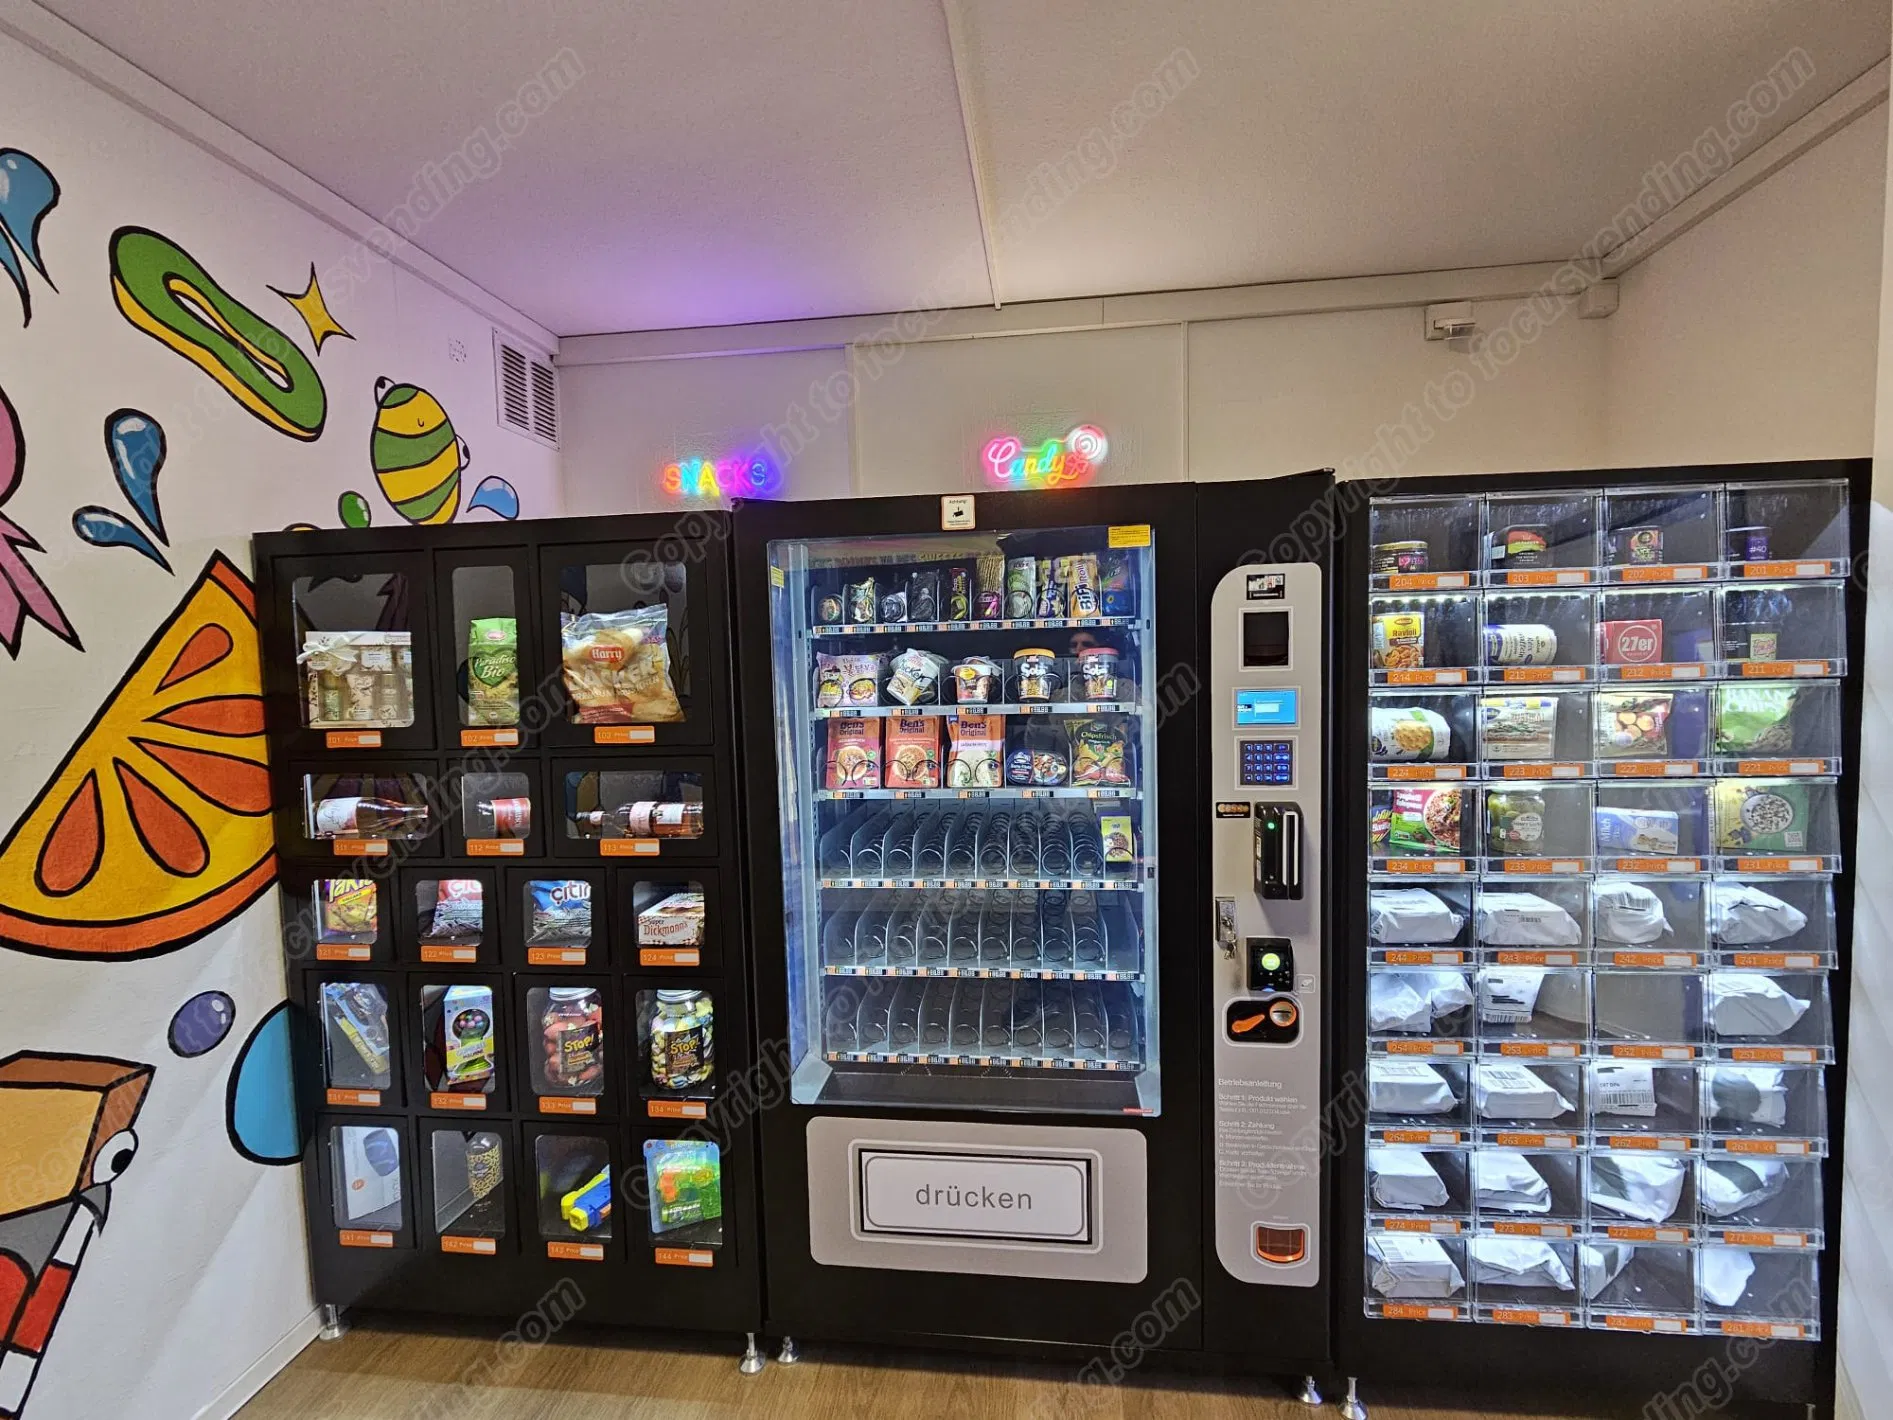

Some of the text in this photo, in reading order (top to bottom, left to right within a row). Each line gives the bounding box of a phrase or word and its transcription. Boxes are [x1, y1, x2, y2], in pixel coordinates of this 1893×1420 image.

[988, 441, 1078, 485] Candy
[664, 459, 766, 496] SNACKS
[1750, 566, 1767, 574] 201
[1512, 575, 1529, 583] 203
[1628, 571, 1644, 579] 202
[1395, 578, 1412, 587] 204
[1075, 583, 1092, 610] BiFi
[1392, 629, 1417, 637] Ravioli
[1621, 636, 1654, 652] 27er
[591, 648, 622, 660] Harry
[474, 654, 516, 668] Paradiso
[480, 665, 505, 678] Bio
[1748, 665, 1765, 673] 211
[1393, 673, 1410, 682] 214
[1509, 671, 1526, 680] 213
[900, 718, 925, 727] Ben's
[960, 720, 986, 729] Ben's
[839, 727, 864, 735] Original
[899, 726, 925, 734] Original
[960, 728, 986, 736] Original
[1081, 731, 1116, 741] Chipsfrisch
[1393, 769, 1409, 777] 224
[1392, 863, 1408, 871] 234
[1509, 863, 1526, 871] 233
[1743, 861, 1759, 869] 231
[1391, 954, 1407, 962] 244
[1503, 955, 1518, 963] 243
[564, 1034, 594, 1053] STOP!
[670, 1037, 700, 1054] STOP!
[1392, 1044, 1408, 1052] 254
[1389, 1134, 1405, 1142] 264
[1503, 1137, 1518, 1145] 263
[1615, 1139, 1630, 1147] 262
[915, 1184, 1033, 1211] drücken
[1390, 1222, 1405, 1230] 274
[1499, 1225, 1515, 1233] 273
[1613, 1229, 1628, 1237] 272
[1730, 1233, 1745, 1242] 271
[1388, 1307, 1403, 1315] 284
